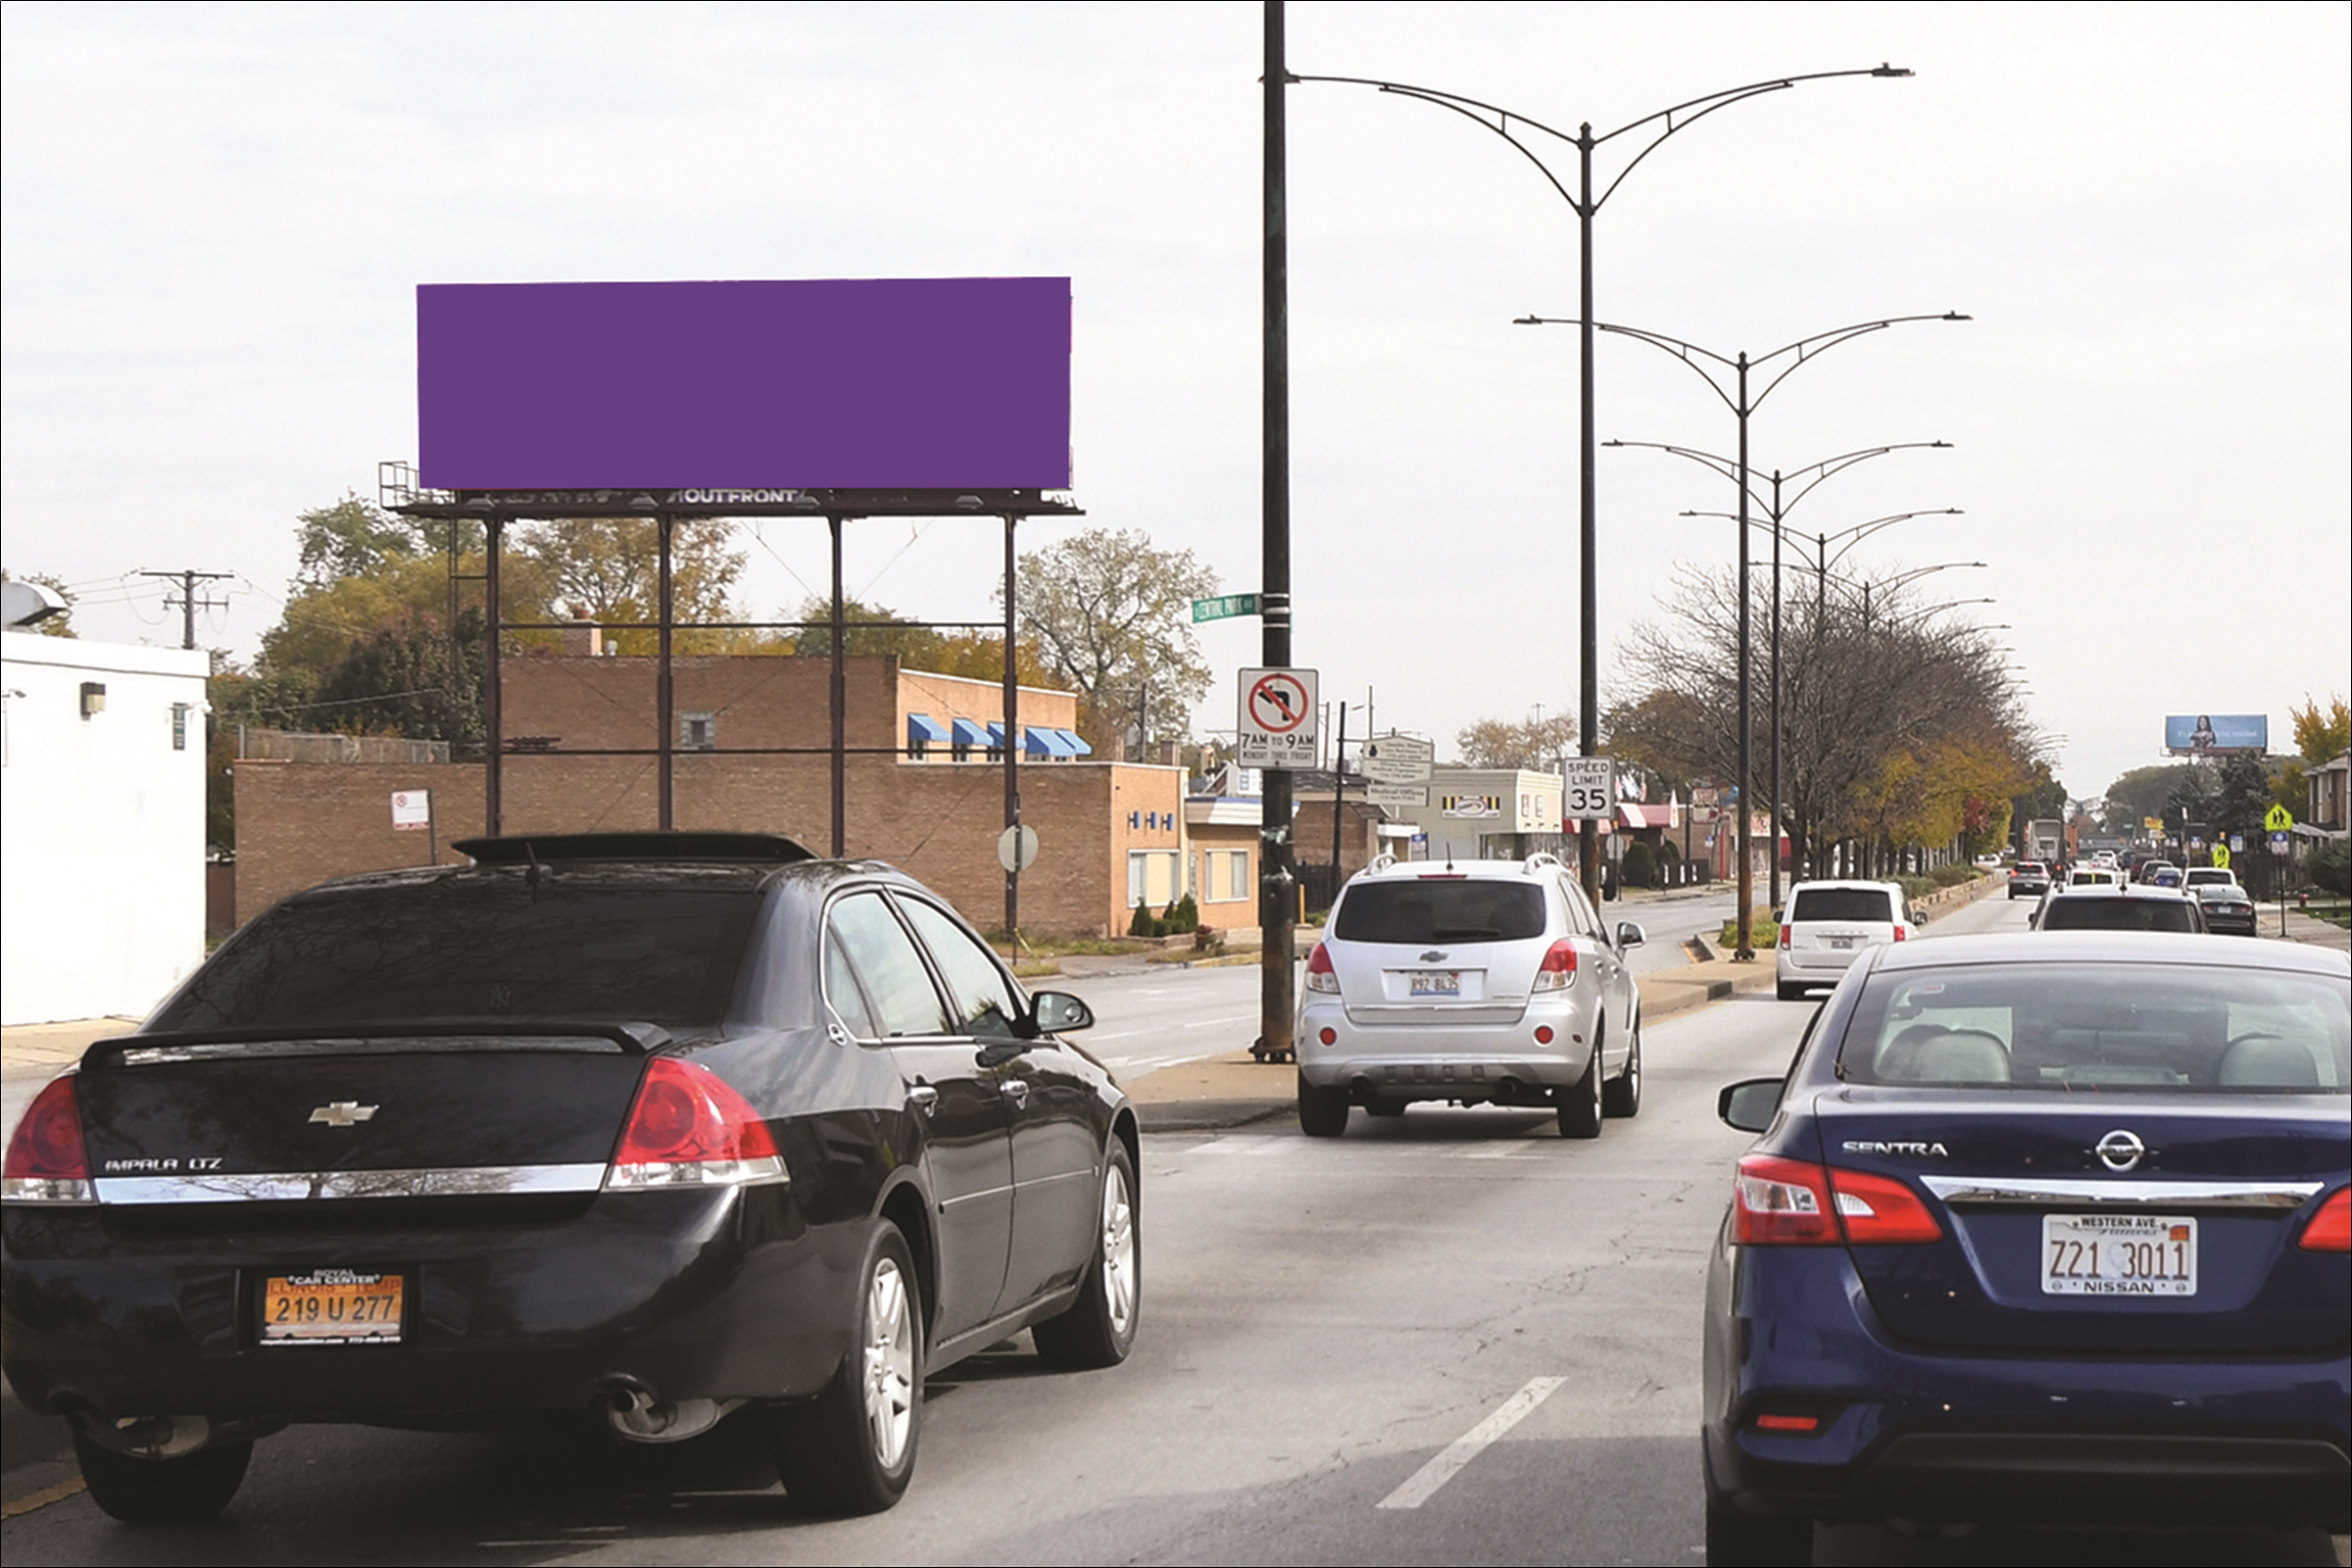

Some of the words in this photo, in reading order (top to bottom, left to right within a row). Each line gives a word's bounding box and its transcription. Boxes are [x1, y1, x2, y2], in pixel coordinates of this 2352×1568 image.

[684, 489, 798, 504] OUTFRONT
[1225, 597, 1243, 615] PARK
[1272, 737, 1283, 746] TO
[1271, 752, 1288, 760] THRU
[1291, 752, 1313, 760] FRIDAY
[1568, 761, 1608, 773] SPEED
[1572, 775, 1604, 785] LIMIT
[1570, 788, 1606, 811] 35
[1842, 1141, 1949, 1156] SENTRA
[105, 1158, 178, 1172] IMPALA
[188, 1157, 222, 1170] LTZ
[2081, 1217, 2132, 1227] WESTERN
[2049, 1240, 2102, 1278] Z21
[2122, 1242, 2188, 1281] 3011
[295, 1276, 322, 1285] CAR
[324, 1275, 374, 1285] CENTER
[2083, 1282, 2154, 1293] NISSAN
[276, 1297, 319, 1322] 219
[328, 1297, 344, 1321] U
[353, 1295, 395, 1321] 277
